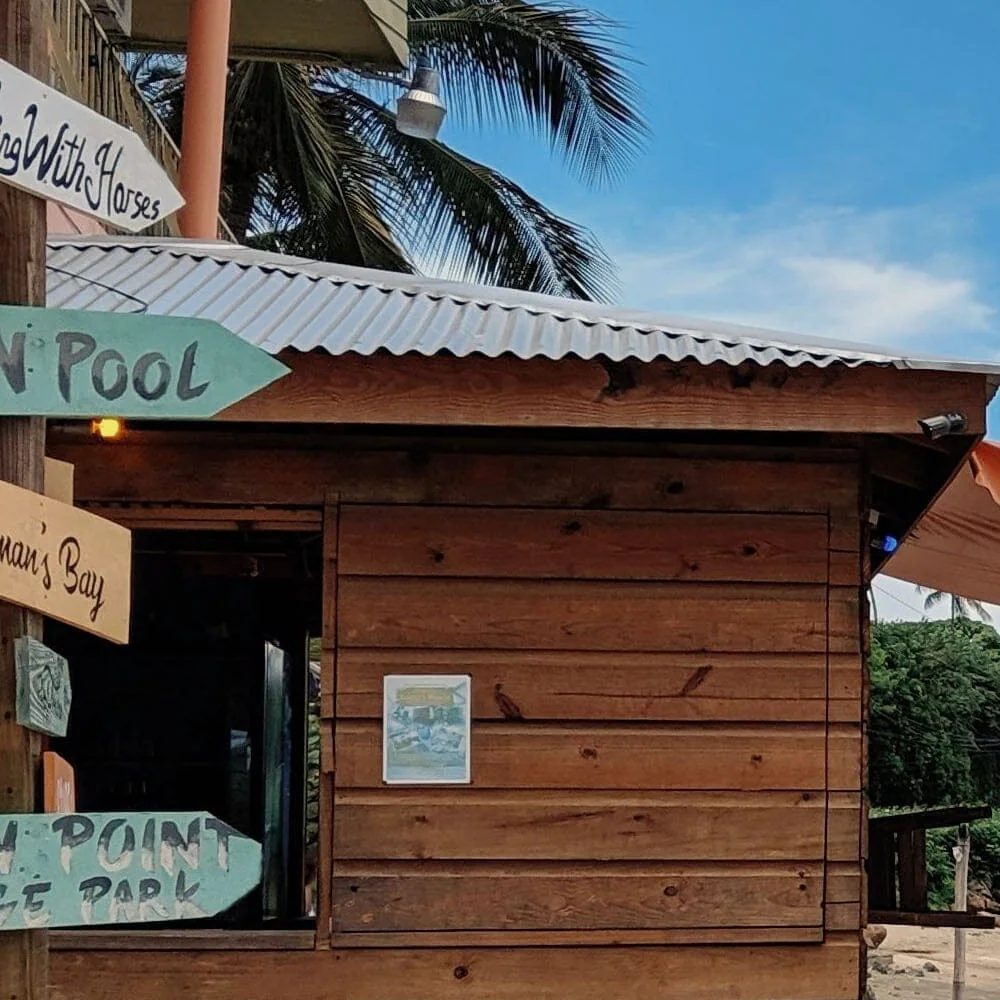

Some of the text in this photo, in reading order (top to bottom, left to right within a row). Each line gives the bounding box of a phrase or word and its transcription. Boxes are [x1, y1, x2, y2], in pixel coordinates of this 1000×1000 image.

[23, 104, 87, 193] With
[85, 140, 161, 221] Horses
[55, 331, 211, 404] POOL
[58, 536, 105, 623] Bay
[52, 814, 250, 877] POINT
[79, 870, 207, 925] PARK
